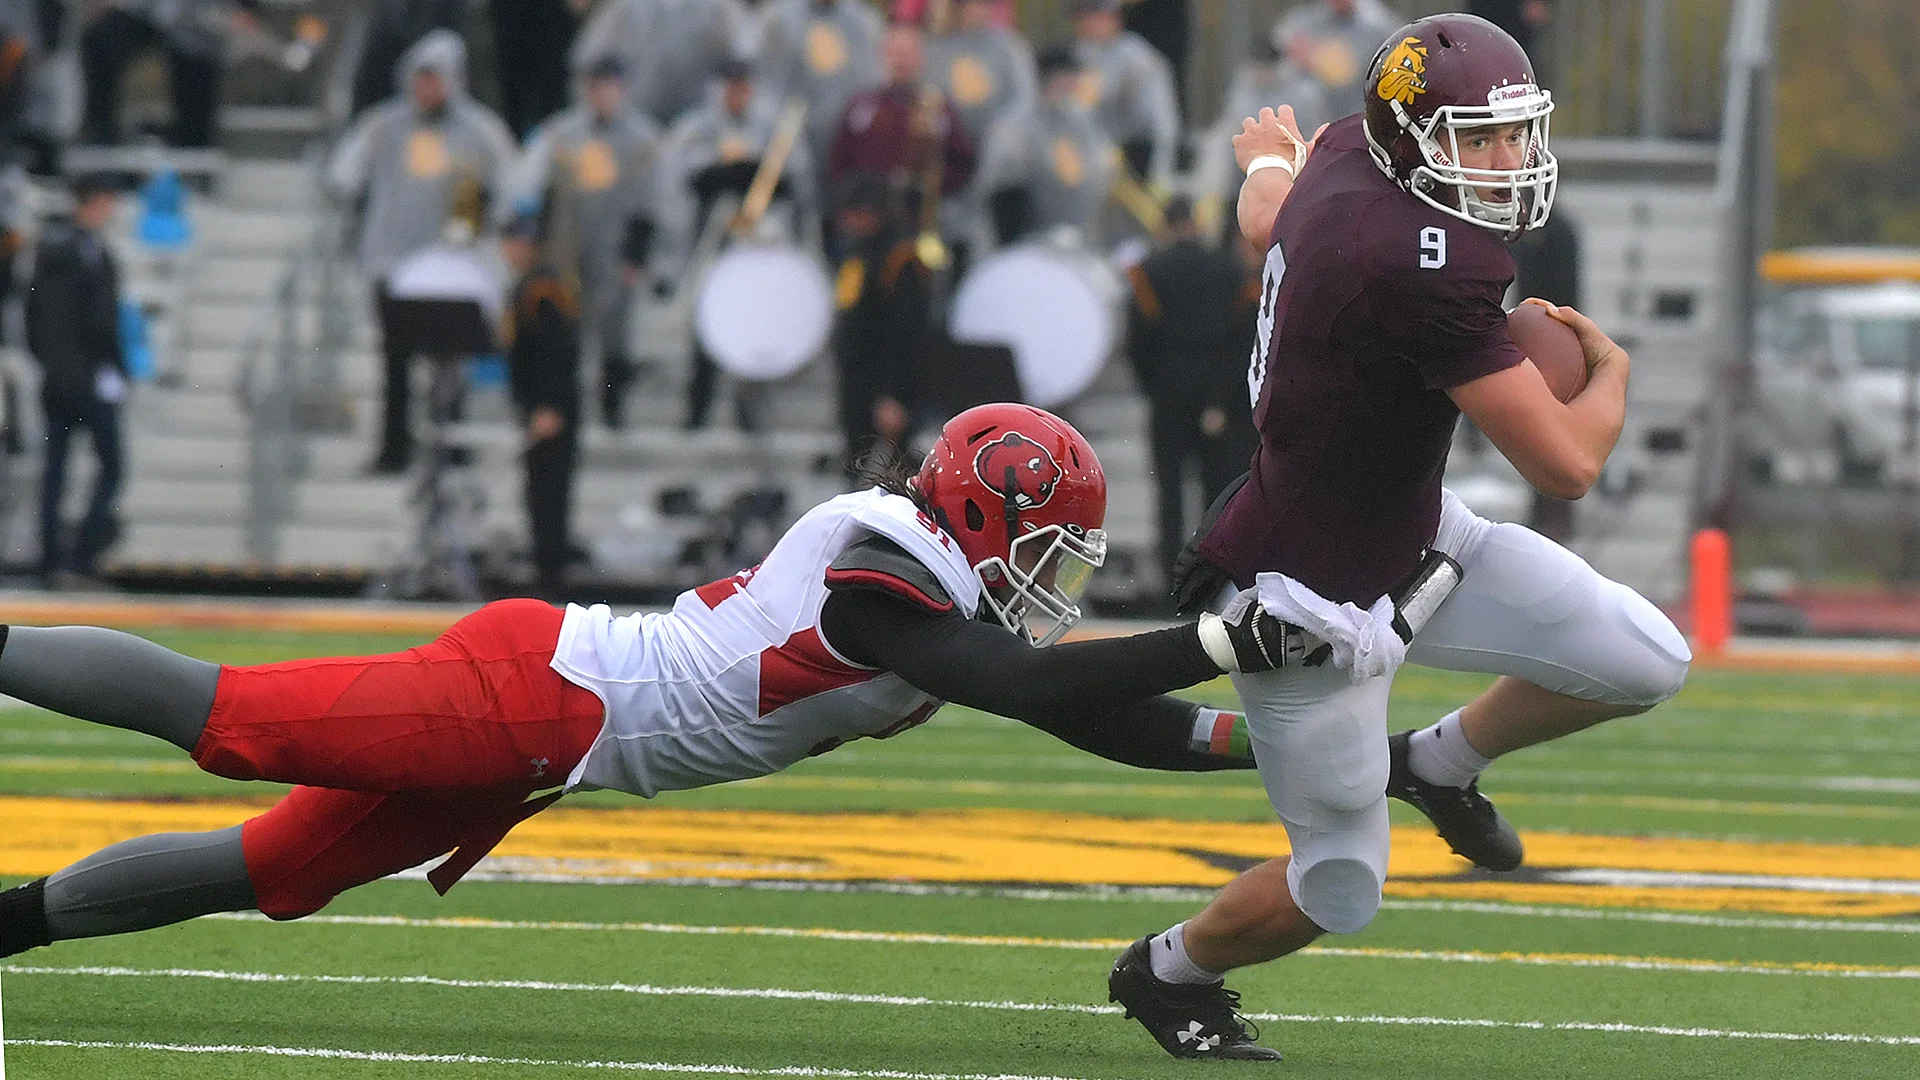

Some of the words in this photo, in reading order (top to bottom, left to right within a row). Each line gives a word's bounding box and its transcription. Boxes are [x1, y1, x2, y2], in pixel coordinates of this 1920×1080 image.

[1501, 87, 1527, 100] Riddell
[1420, 226, 1446, 269] 9
[916, 510, 951, 553] 91
